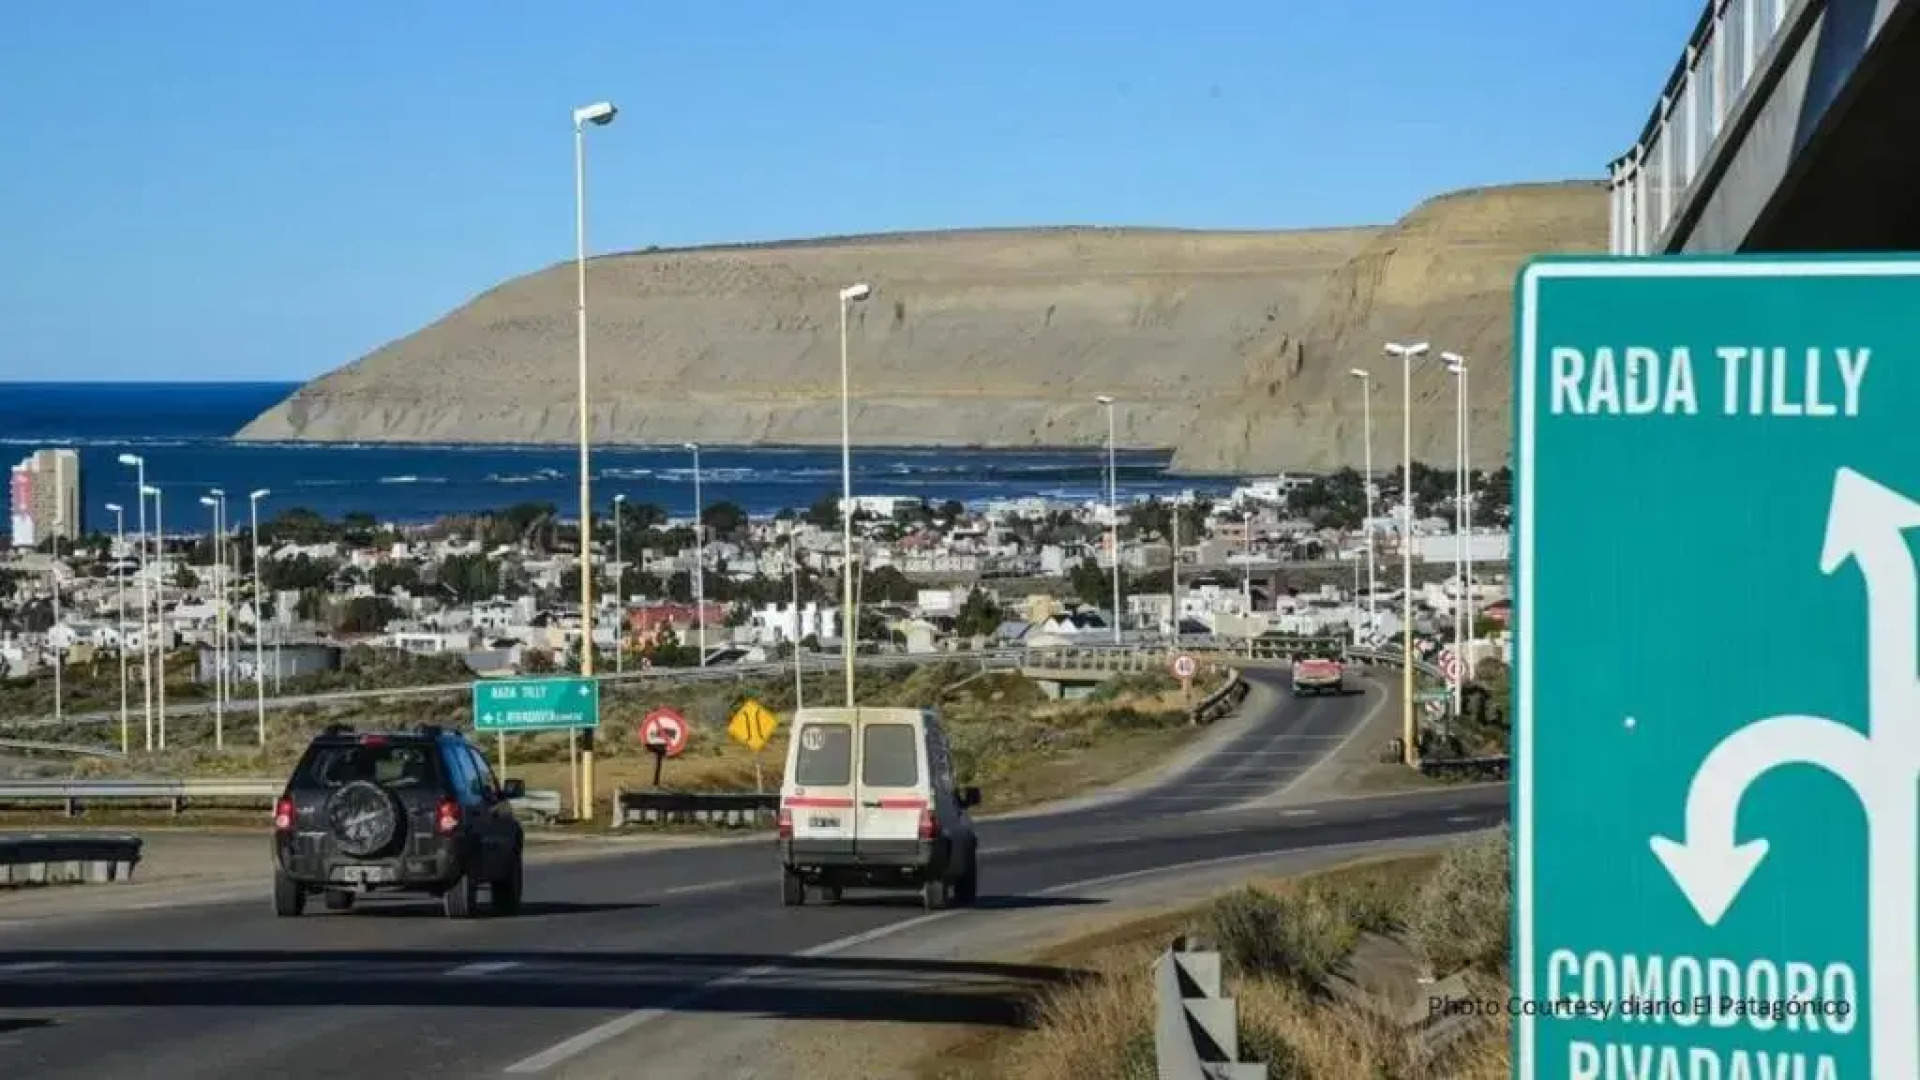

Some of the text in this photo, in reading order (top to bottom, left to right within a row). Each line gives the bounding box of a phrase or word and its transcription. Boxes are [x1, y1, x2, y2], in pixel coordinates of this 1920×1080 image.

[1550, 346, 1871, 416] RADA TILLY
[1548, 949, 1858, 1034] COMODORO
